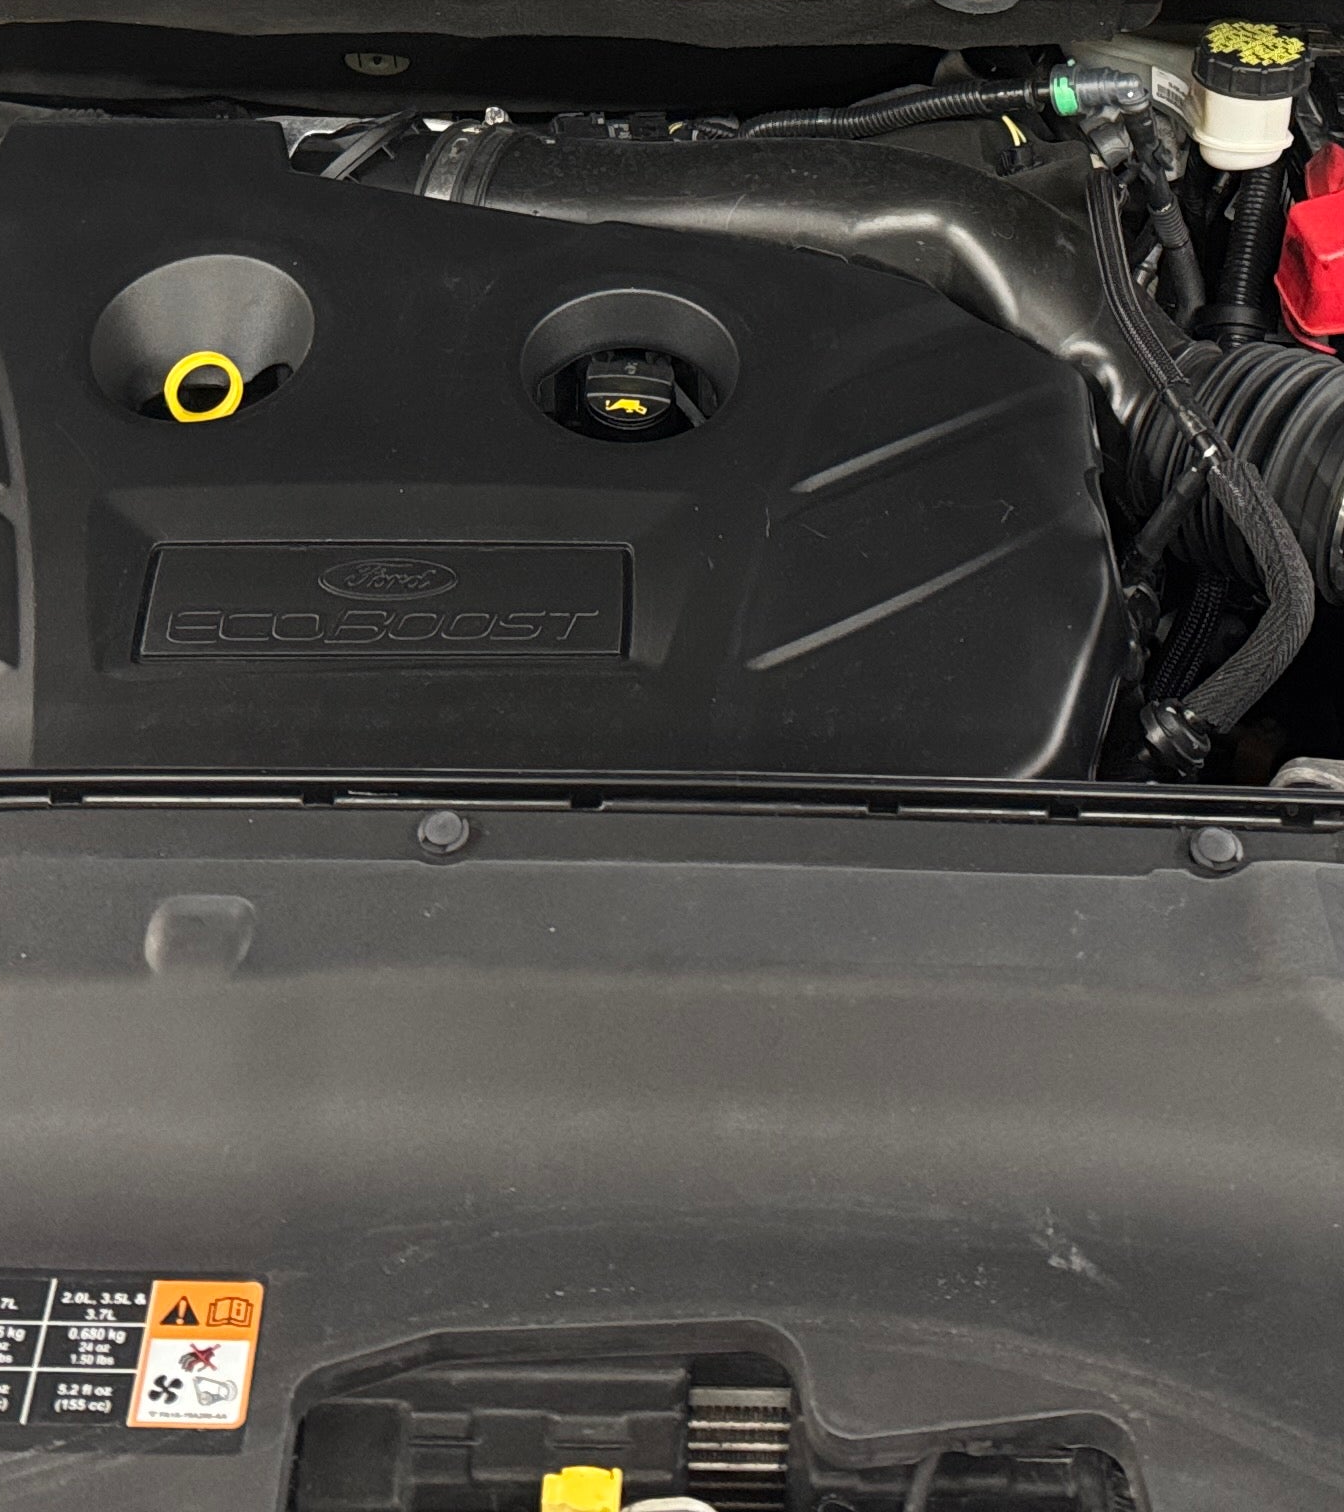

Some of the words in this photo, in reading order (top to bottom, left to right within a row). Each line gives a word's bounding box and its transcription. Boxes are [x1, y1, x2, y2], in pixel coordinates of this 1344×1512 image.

[345, 562, 437, 589] Ford
[60, 1291, 97, 1306] 2.0L,
[100, 1292, 132, 1306] 3.5L
[134, 1293, 147, 1306] &
[84, 1308, 117, 1321] 3.7L
[6, 1326, 27, 1343] kg
[67, 1327, 106, 1341] 0.680
[107, 1328, 127, 1344] kg
[78, 1342, 94, 1353] 24
[95, 1343, 111, 1354] oz
[69, 1353, 94, 1365] 1.50
[95, 1354, 115, 1366] lbs
[56, 1383, 80, 1396] 5.2
[81, 1383, 93, 1396] fl
[93, 1386, 113, 1397] oz
[53, 1398, 86, 1413] (155
[86, 1399, 112, 1414] cc)
